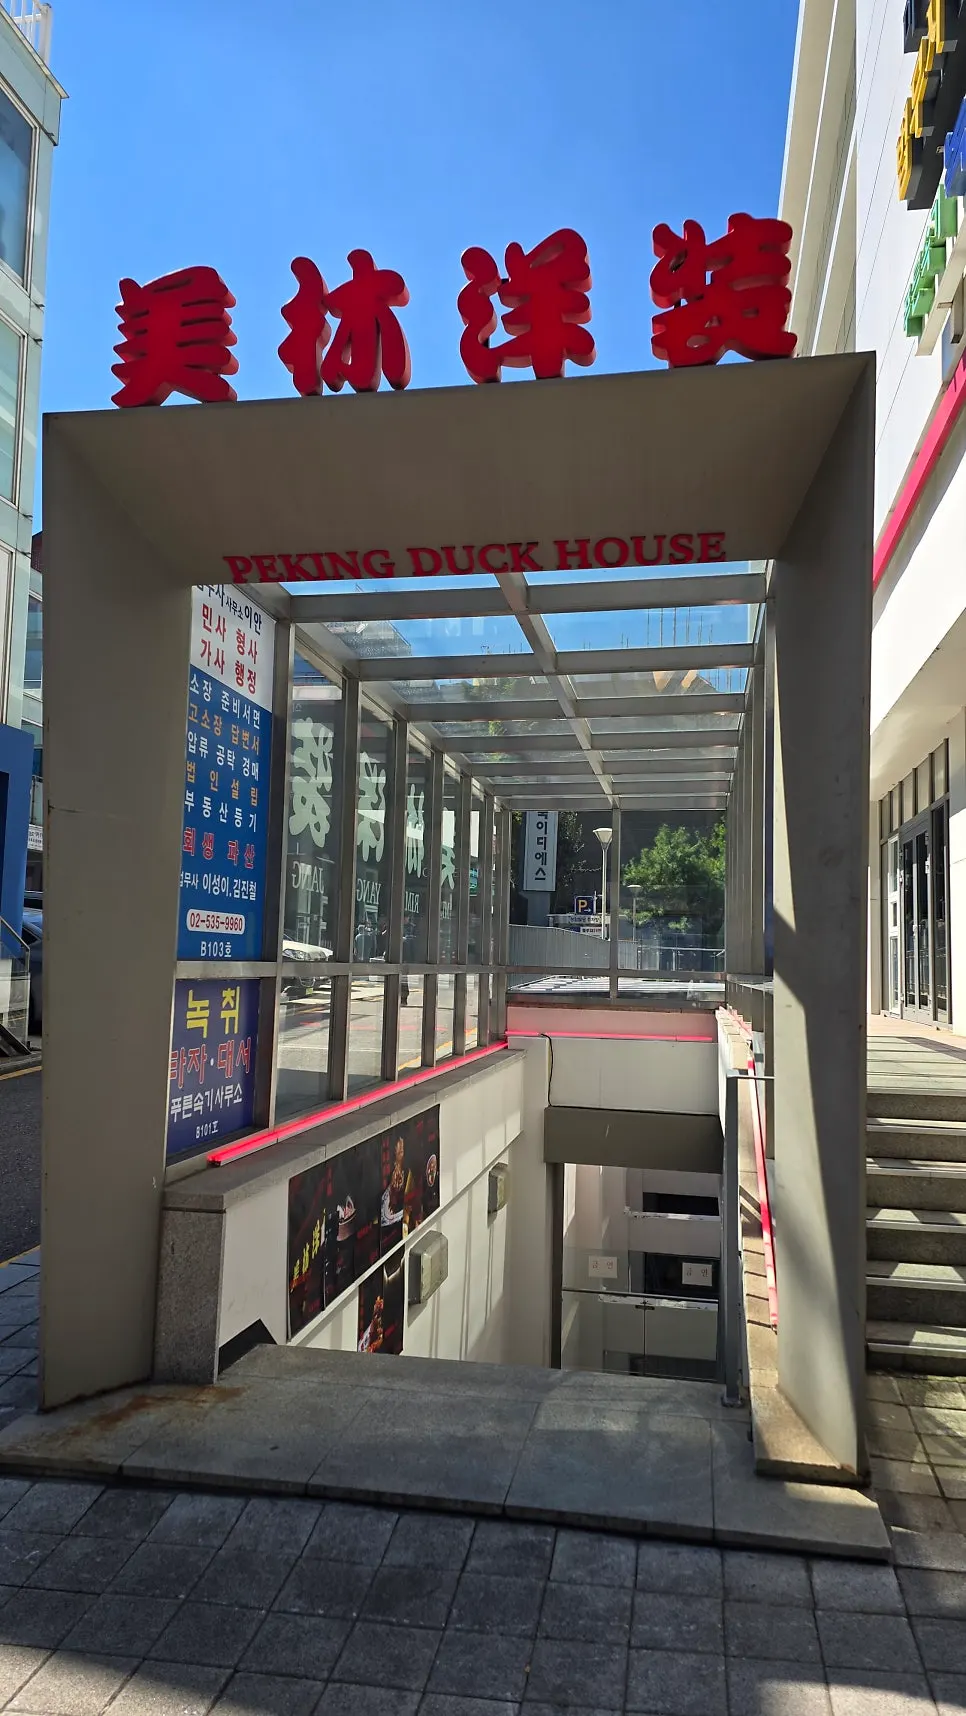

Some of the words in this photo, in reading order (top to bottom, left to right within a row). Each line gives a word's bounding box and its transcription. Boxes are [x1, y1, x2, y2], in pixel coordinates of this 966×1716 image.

[222, 550, 396, 584] PEKING
[406, 541, 543, 577] DUCK
[553, 532, 727, 571] HOUSE
[201, 603, 227, 643] 민사
[235, 627, 258, 664] 형사
[200, 638, 226, 676] 가사
[234, 659, 257, 695] 행정
[189, 673, 212, 702] 소장
[221, 690, 261, 730] 준비서면
[188, 702, 222, 737] 고소장
[230, 723, 260, 757] 답변서
[186, 731, 208, 760] 압류
[216, 744, 236, 771] 공탁
[242, 756, 260, 783] 경매
[189, 911, 243, 932] 02-535-9960
[578, 899, 588, 913] P
[200, 940, 232, 958] B103호
[170, 1083, 243, 1123] 푸른속기사무소
